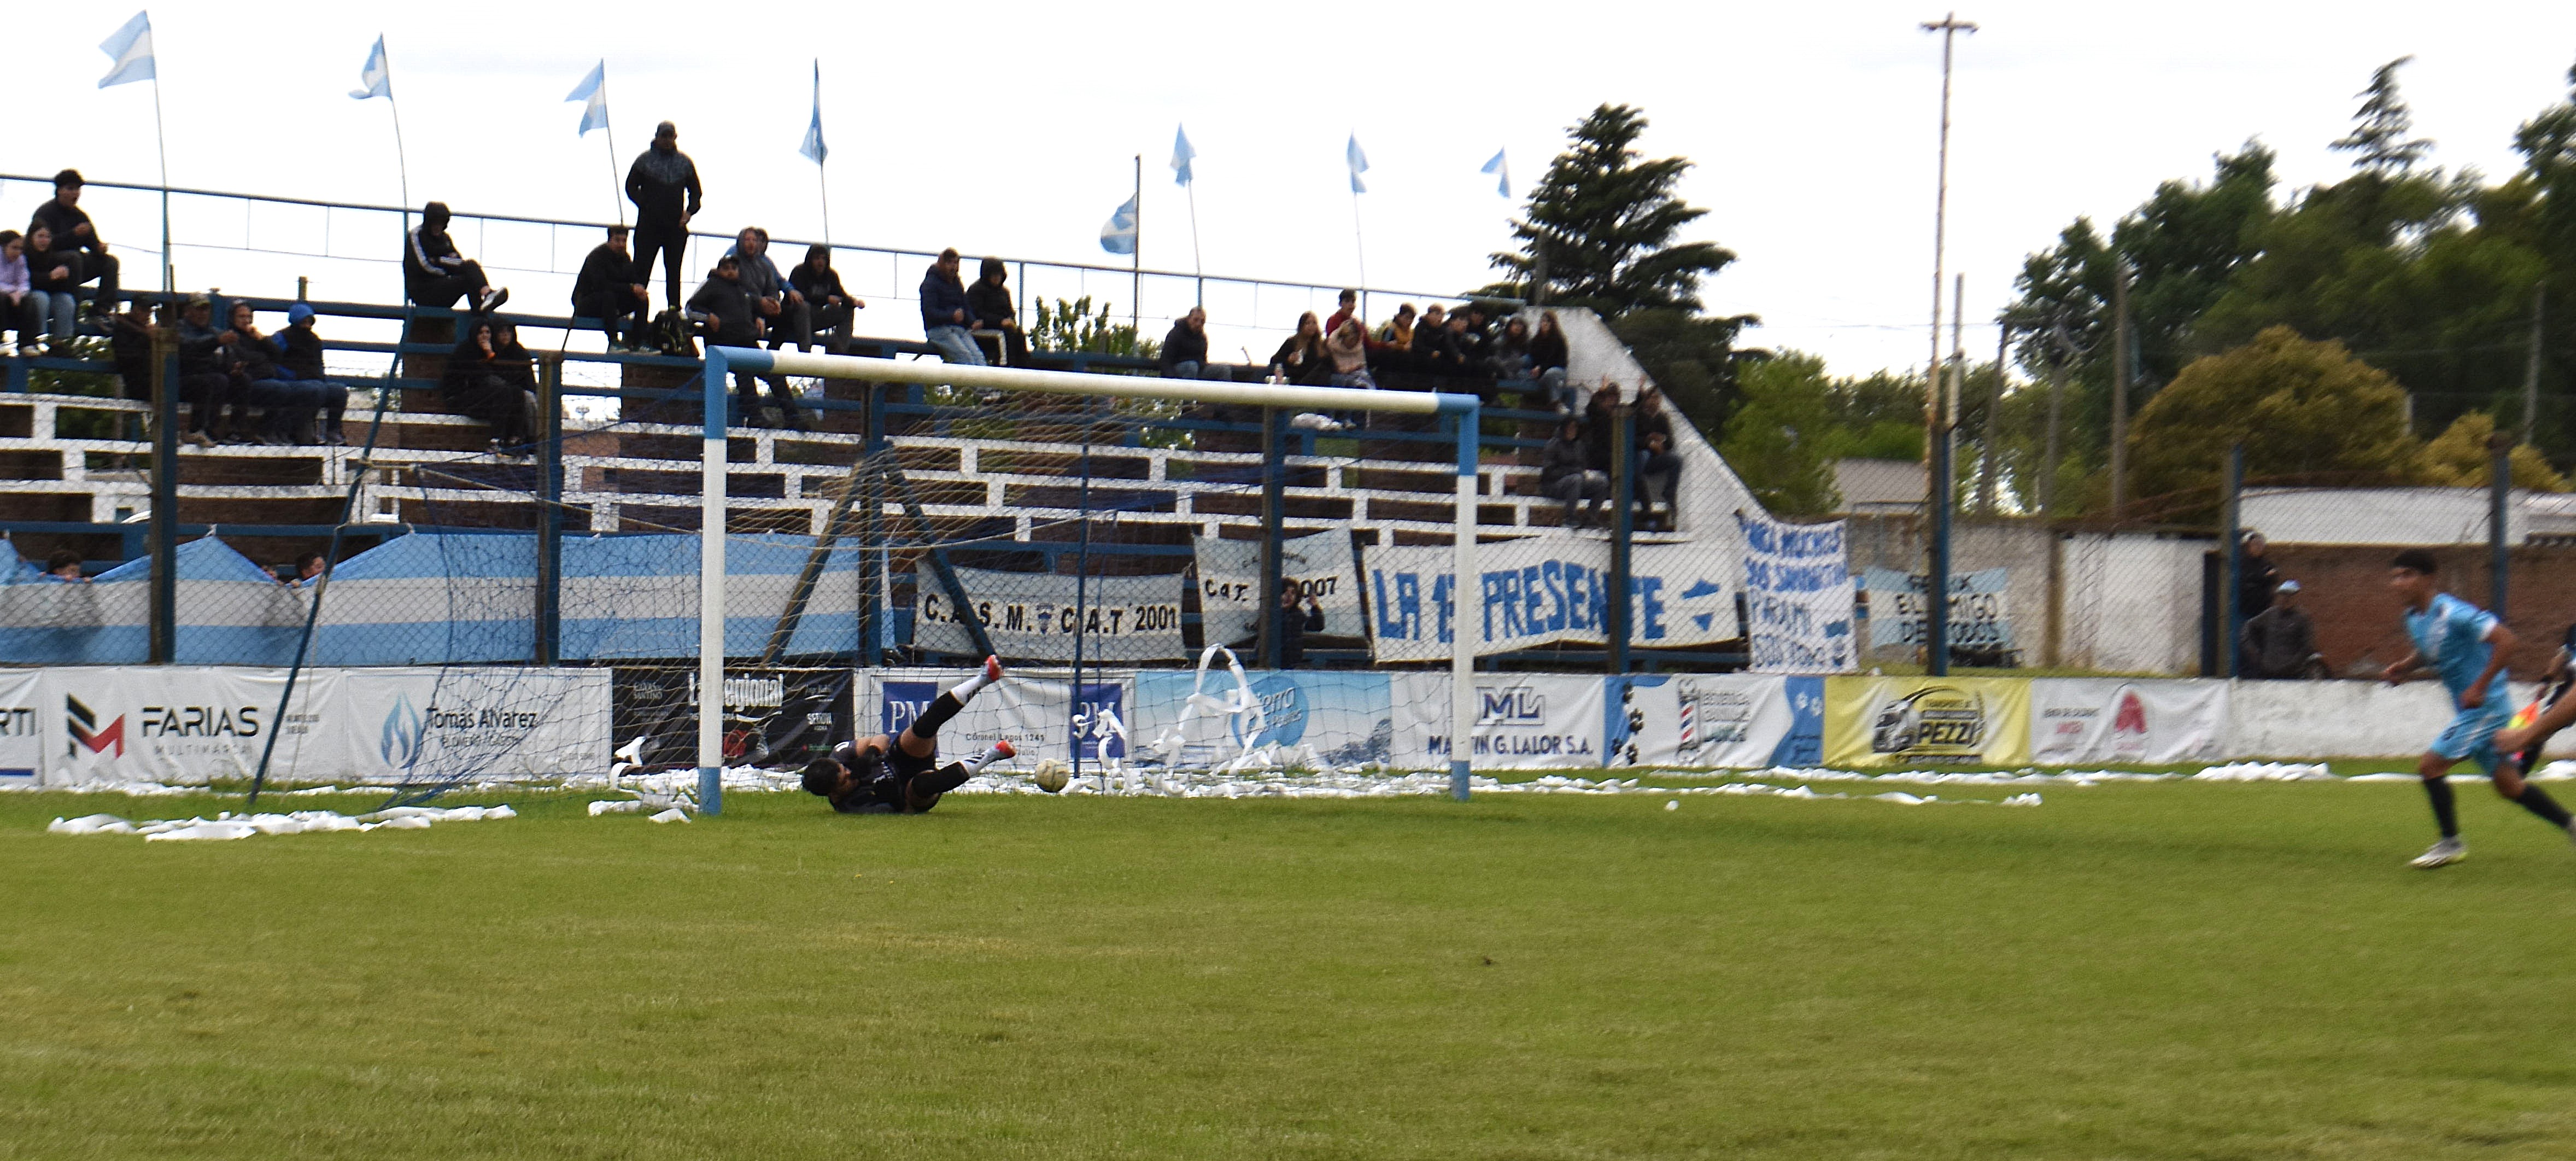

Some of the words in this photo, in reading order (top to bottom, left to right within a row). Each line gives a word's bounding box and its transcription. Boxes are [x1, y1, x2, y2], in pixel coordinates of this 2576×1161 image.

[1299, 575, 1339, 598] 007
[1373, 569, 1420, 640] LA
[1431, 573, 1455, 643] 1
[1482, 559, 1665, 641] PRESENE
[1947, 592, 1997, 620] MIGO
[1135, 605, 1176, 631] 2001
[1947, 620, 1999, 643] ODOS
[724, 673, 784, 711] egional
[1484, 693, 1540, 719] ML
[142, 706, 260, 737] FARIAS
[1428, 736, 1490, 754] MATIN
[1494, 735, 1509, 754] G.
[1513, 735, 1562, 755] LALOR
[1566, 737, 1593, 754] S.A.
